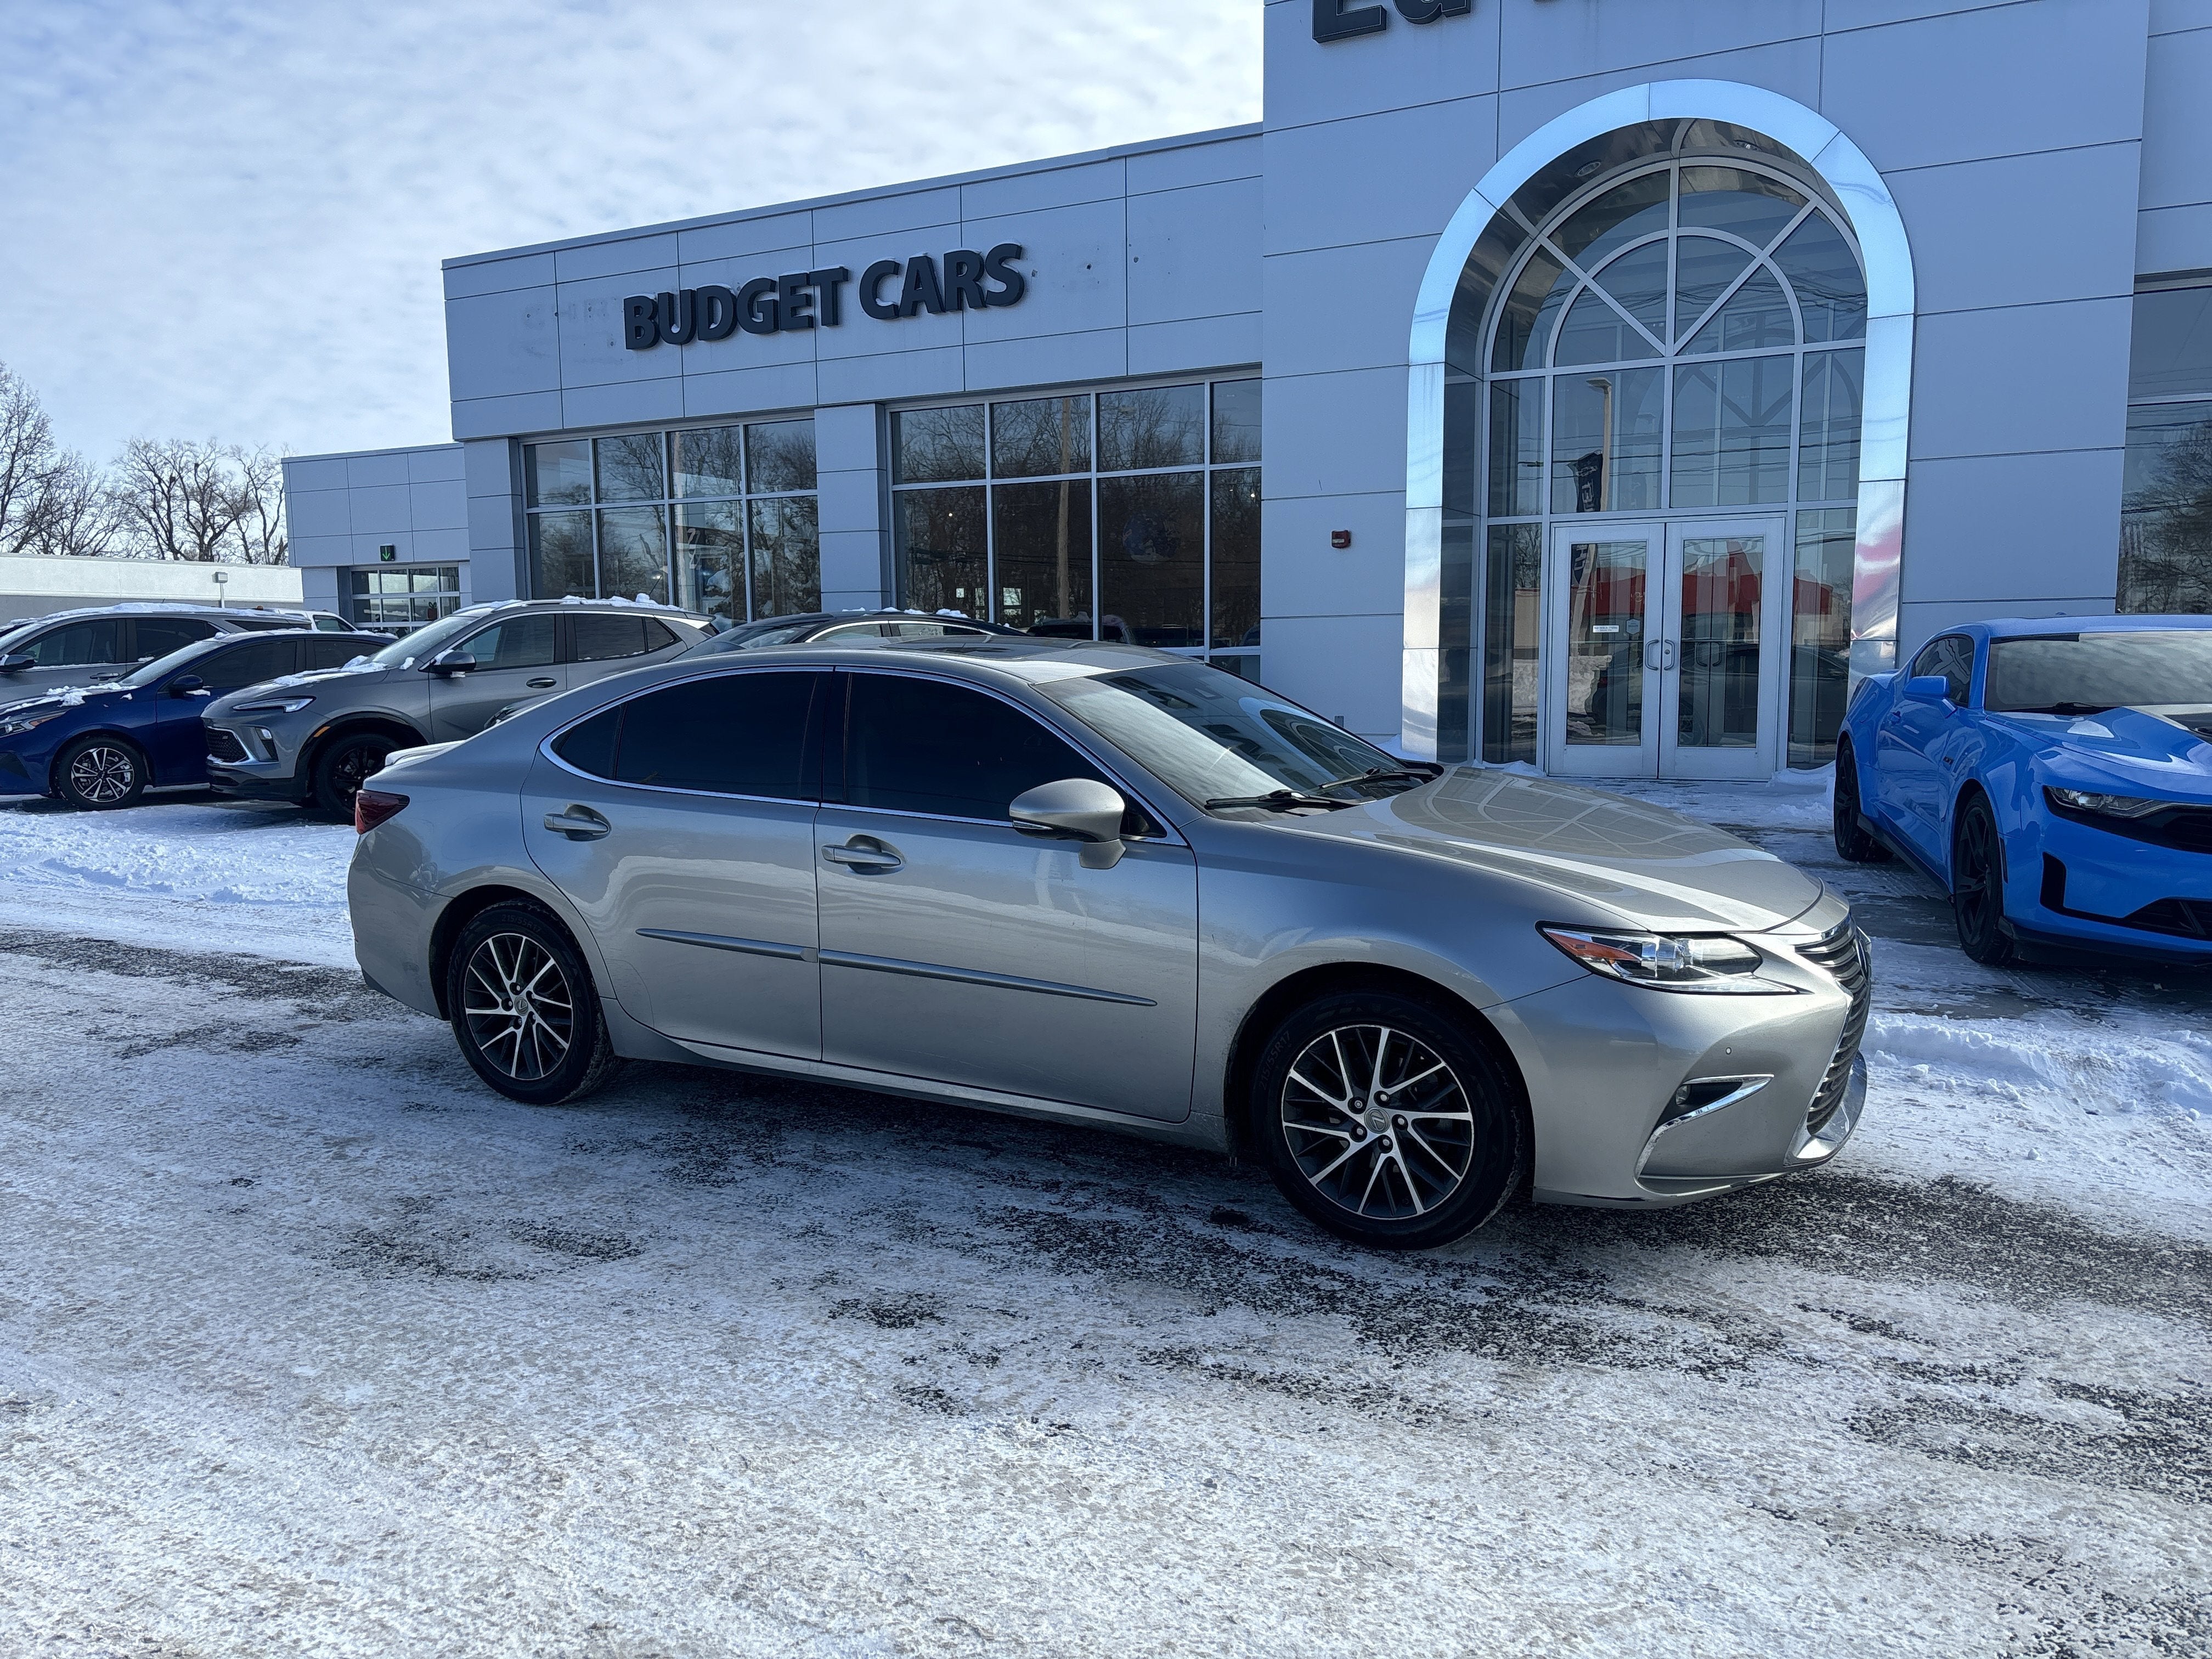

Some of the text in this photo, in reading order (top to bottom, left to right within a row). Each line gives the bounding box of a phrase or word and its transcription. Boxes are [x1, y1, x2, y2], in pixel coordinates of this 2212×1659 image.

[623, 243, 1025, 350] BUDGET CARS
[501, 914, 542, 933] 215/55R17
[1259, 1030, 1290, 1091] 215/55R17
